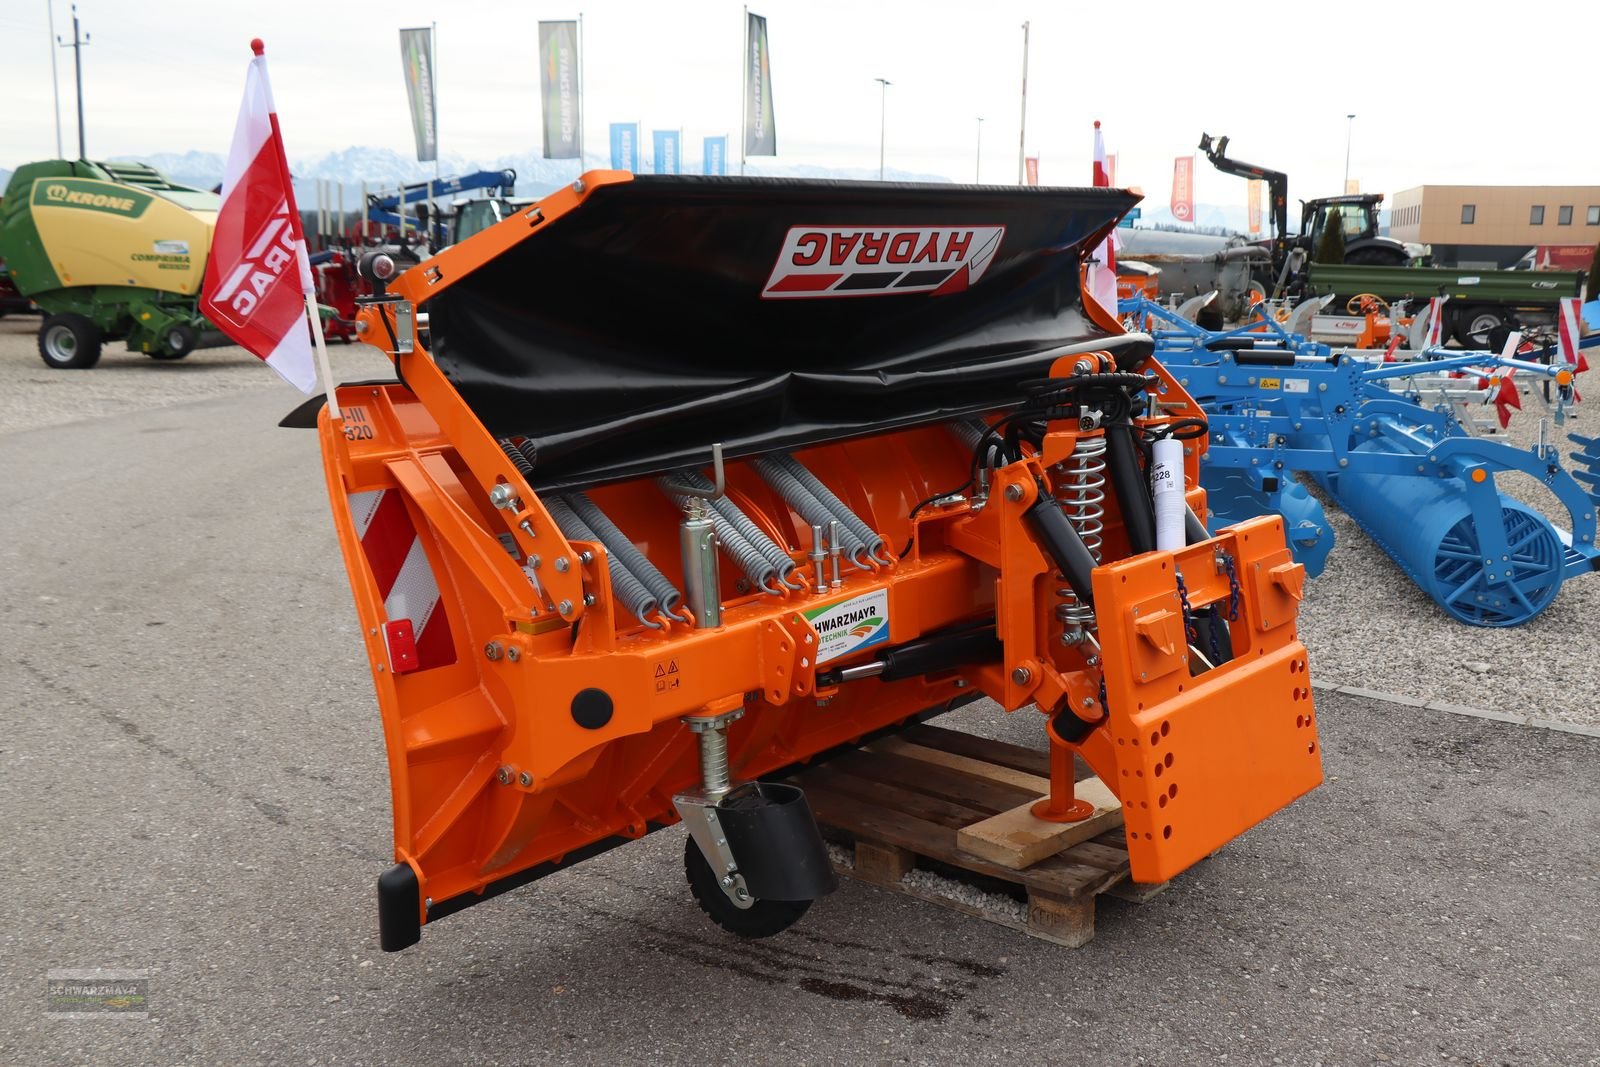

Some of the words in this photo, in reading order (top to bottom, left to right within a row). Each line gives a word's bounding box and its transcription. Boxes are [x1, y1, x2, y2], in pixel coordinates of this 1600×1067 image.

[753, 41, 764, 139] SCHWARZMAYR
[66, 190, 136, 212] KRONE
[131, 253, 191, 264] COMPRIMA
[791, 231, 974, 267] HYDRAC
[814, 605, 876, 634] HWARZMAYR
